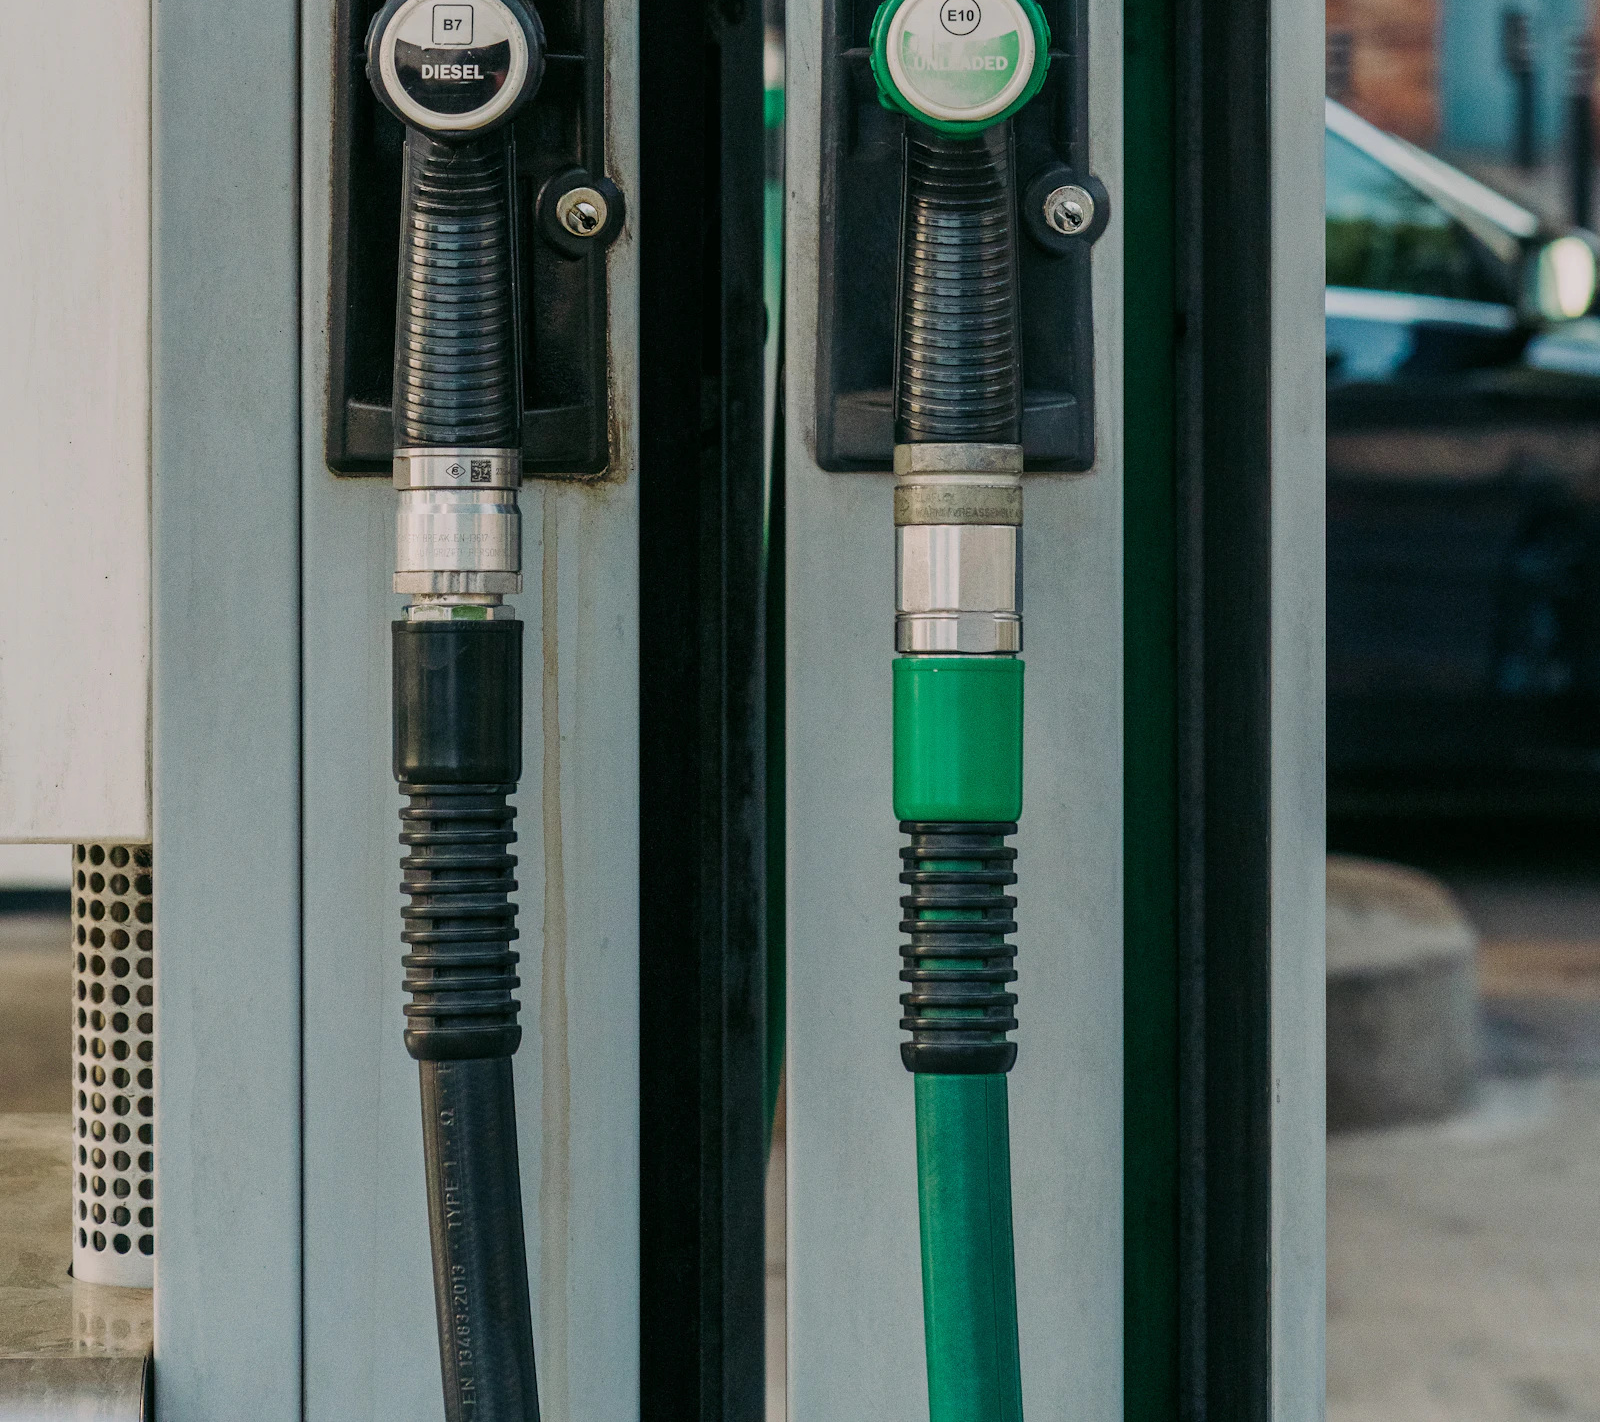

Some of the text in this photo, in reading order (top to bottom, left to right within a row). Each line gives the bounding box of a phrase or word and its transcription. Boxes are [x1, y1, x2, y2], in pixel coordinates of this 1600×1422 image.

[947, 9, 974, 22] E10
[443, 19, 463, 31] B7
[913, 55, 1009, 71] UNLADED
[421, 64, 484, 80] DIESEL
[445, 1177, 462, 1230] TYPE
[461, 1379, 476, 1404] EN
